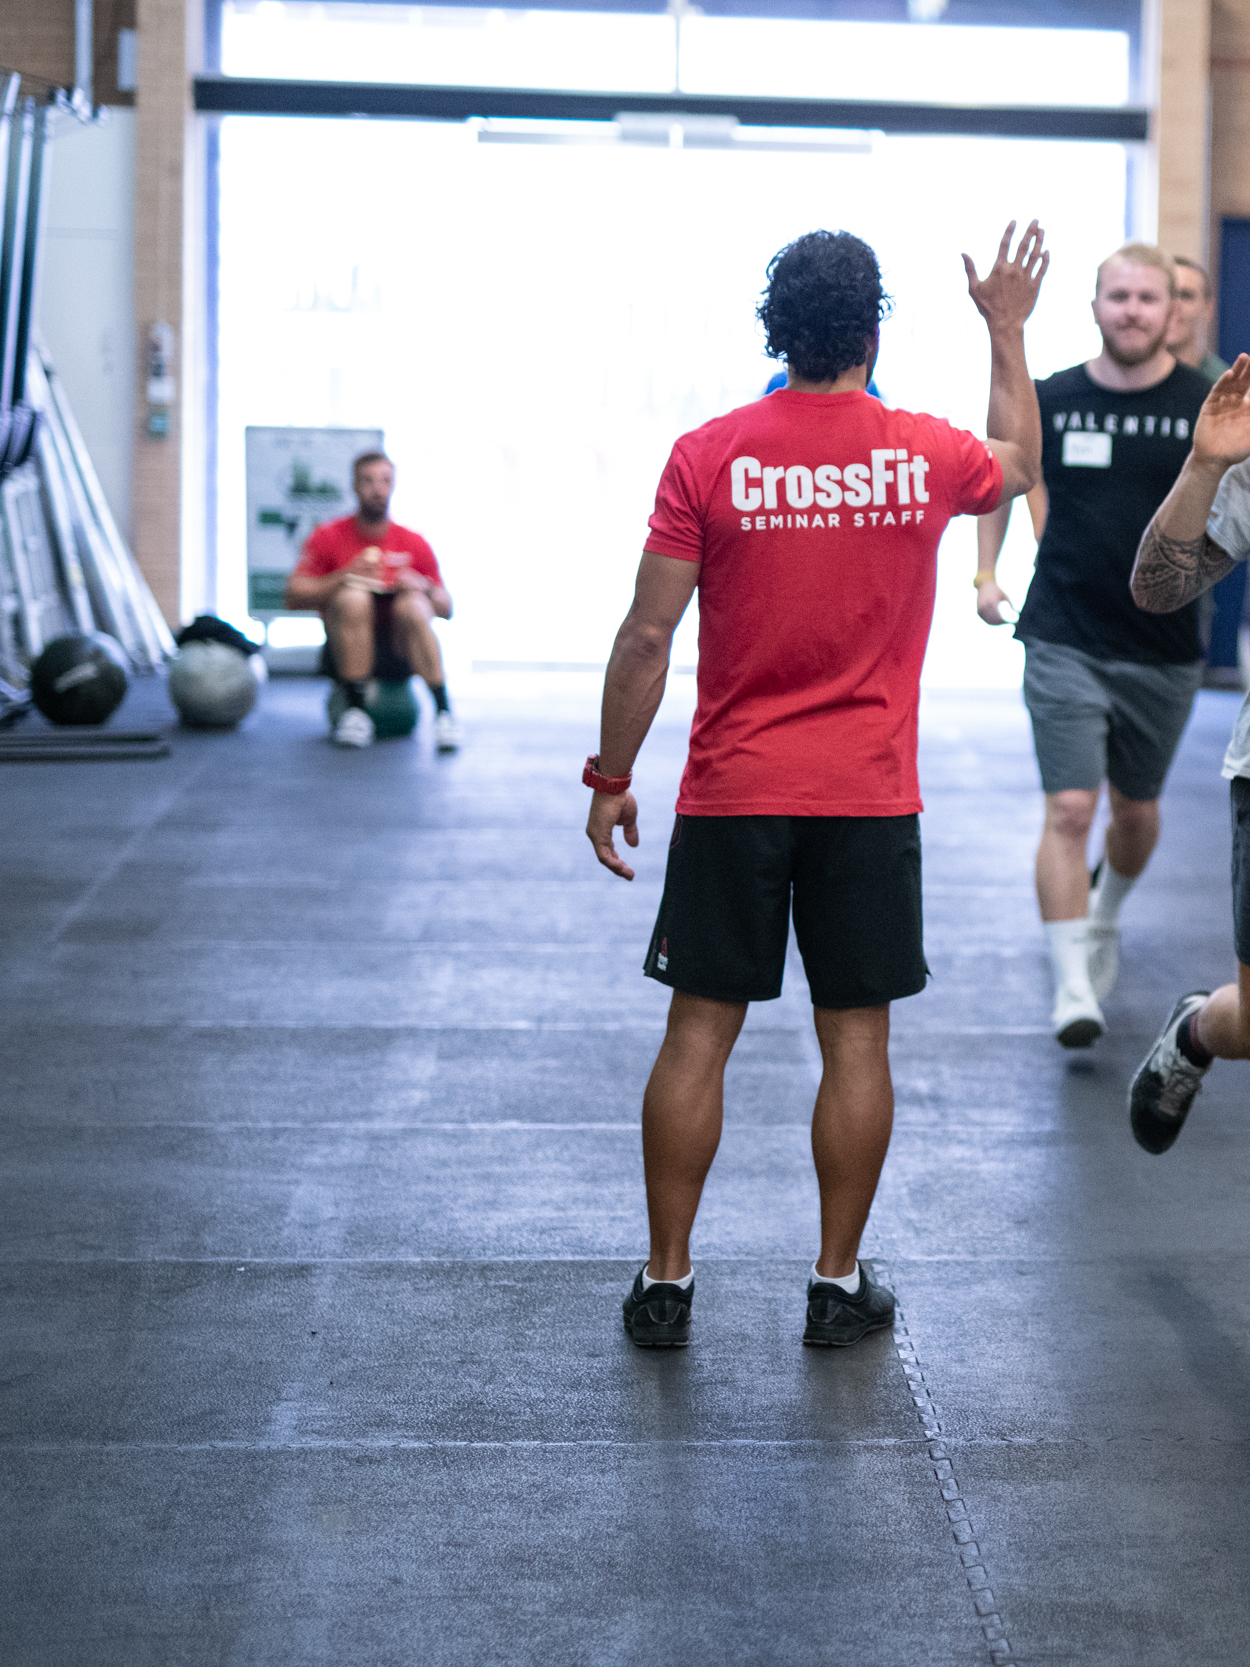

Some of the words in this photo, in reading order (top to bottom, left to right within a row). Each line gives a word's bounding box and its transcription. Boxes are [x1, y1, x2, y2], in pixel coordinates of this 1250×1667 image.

[730, 448, 930, 512] CrossFit
[741, 513, 840, 531] SEMINAR
[853, 510, 925, 527] STAFF
